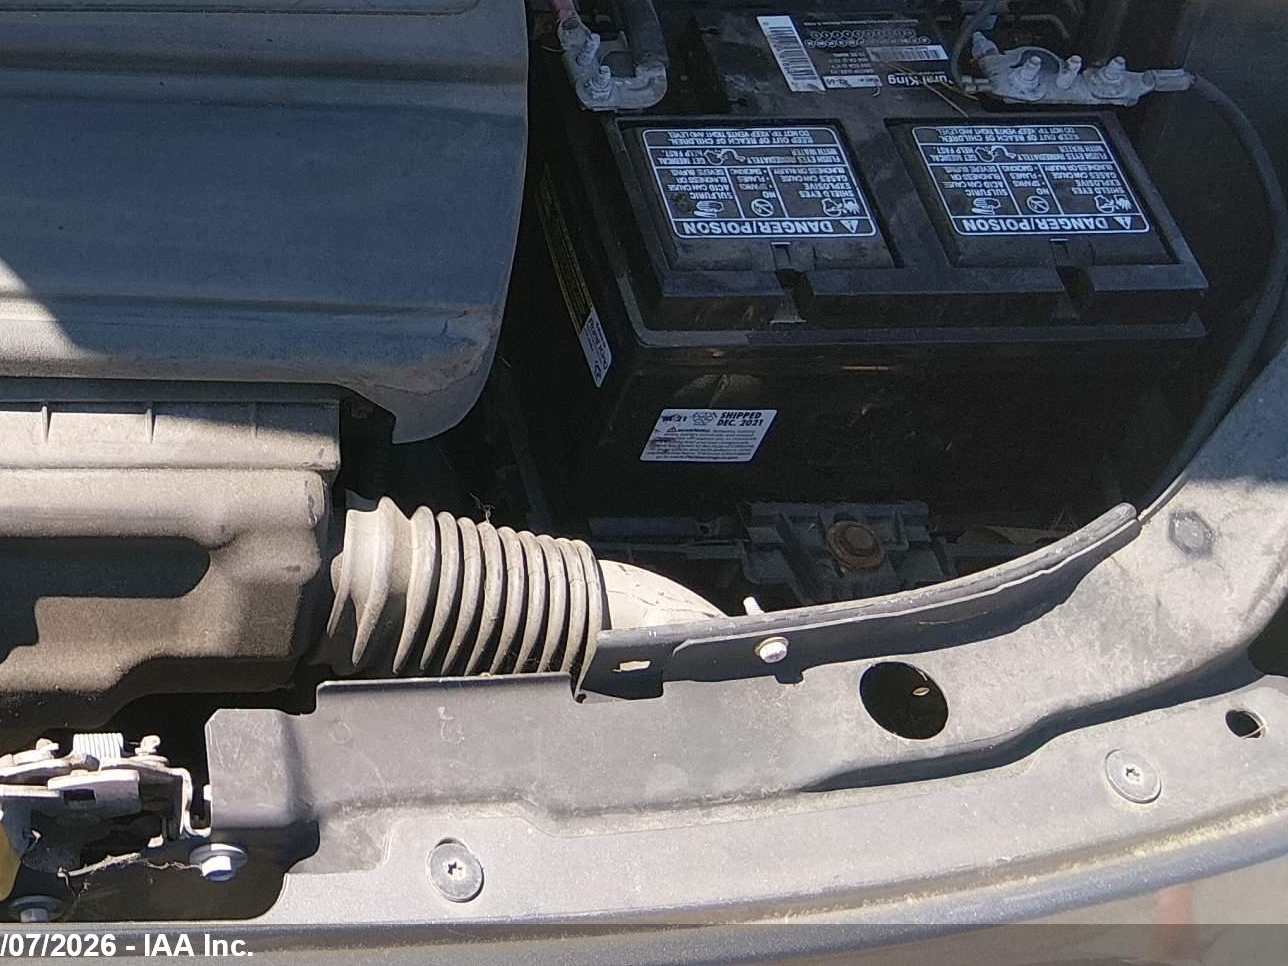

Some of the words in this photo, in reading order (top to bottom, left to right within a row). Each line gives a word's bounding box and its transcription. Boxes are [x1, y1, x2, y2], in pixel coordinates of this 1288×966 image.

[888, 74, 919, 86] King
[683, 221, 833, 233] DANGER/POISON
[962, 218, 1108, 231] DANGER/POISON
[740, 419, 764, 427] 2021
